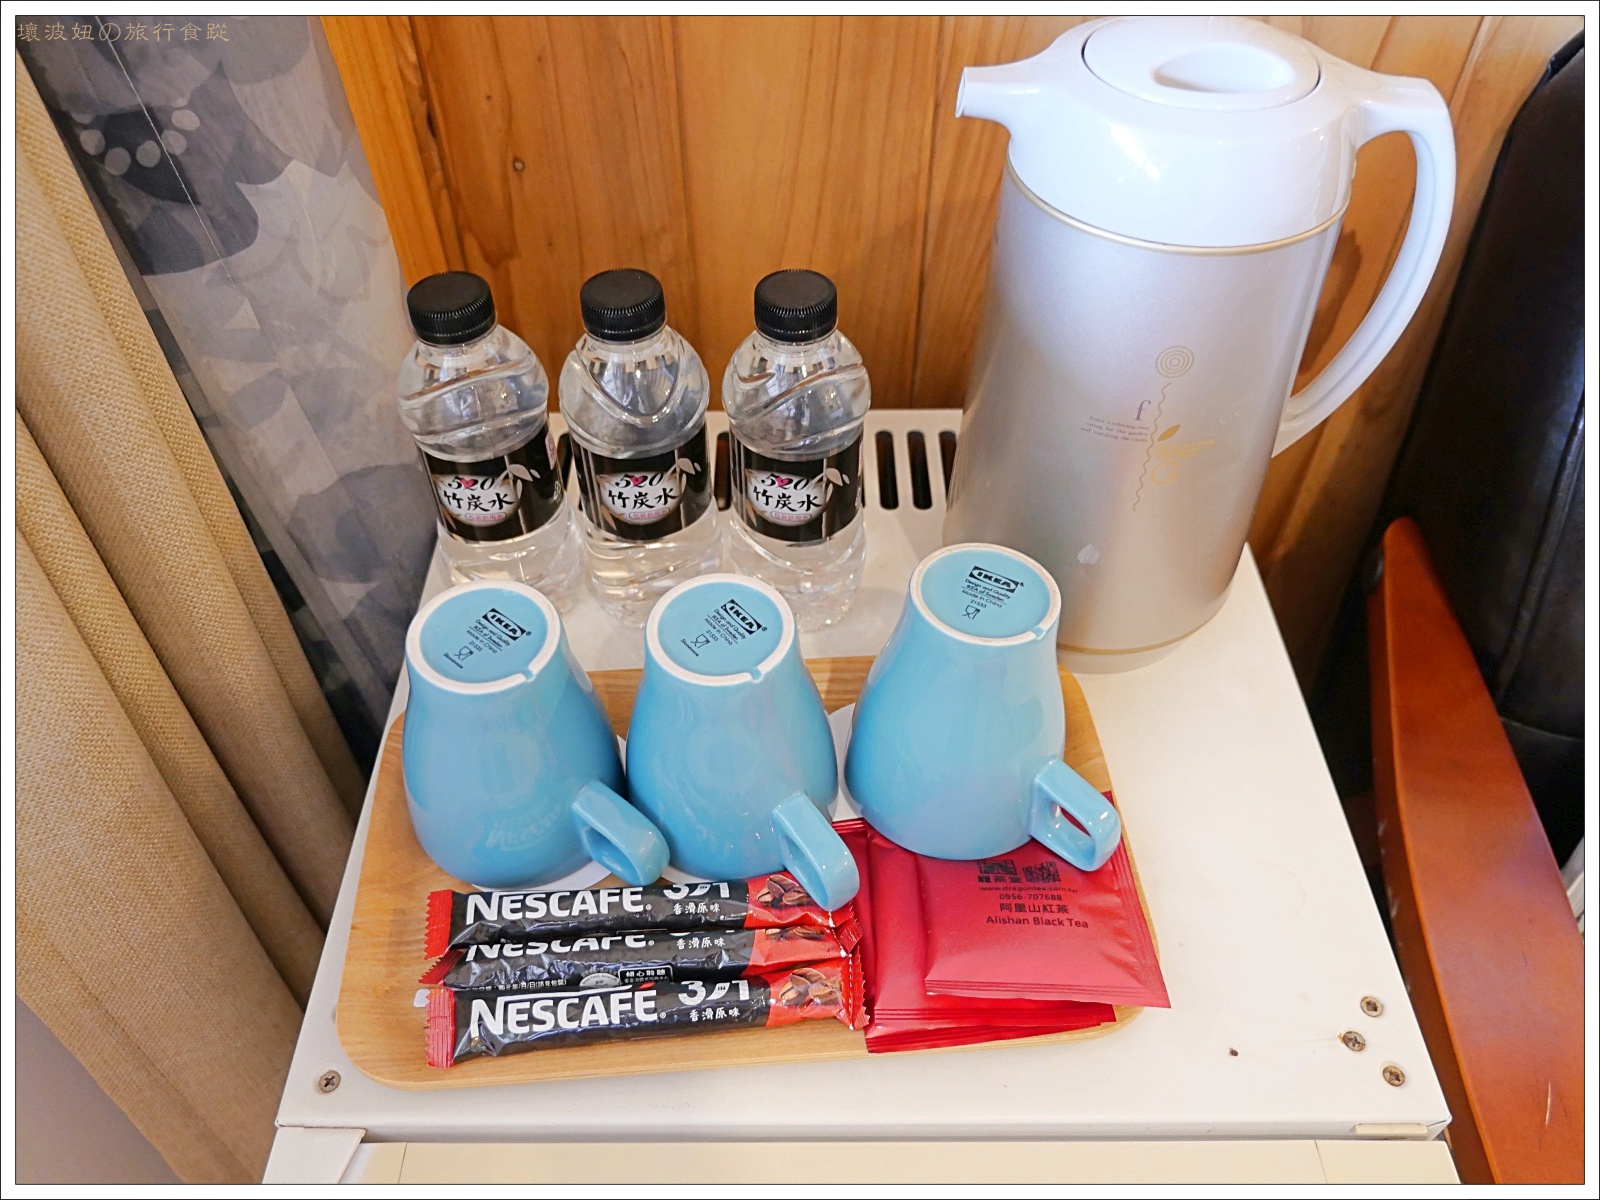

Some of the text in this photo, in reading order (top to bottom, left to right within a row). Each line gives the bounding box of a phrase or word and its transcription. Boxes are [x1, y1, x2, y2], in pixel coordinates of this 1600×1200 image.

[444, 490, 514, 512] 竹炭水
[608, 488, 679, 509] 竹炭水
[753, 486, 822, 512] 竹炭水
[965, 578, 1011, 600] Design and Quality
[986, 591, 1004, 602] Sweden
[962, 590, 978, 598] Made
[986, 599, 1002, 608] China
[970, 600, 986, 608] 21533
[475, 619, 489, 630] Design
[496, 634, 510, 646] Quality
[705, 618, 717, 630] Made
[720, 632, 733, 646] China
[714, 609, 746, 640] Design and Quality
[466, 630, 480, 640] Made
[484, 643, 497, 654] China
[488, 636, 503, 648] Sweden
[725, 627, 738, 641] Sweden
[979, 886, 1078, 894] www.dragontea.com.tw
[673, 902, 720, 915] 香滑原味
[999, 903, 1069, 914] 阿里山紅茶
[986, 916, 1089, 928] Alishan Black Tea
[676, 937, 726, 950] 香滑原味
[678, 980, 706, 1006] 3
[690, 1007, 740, 1022] 香滑原味
